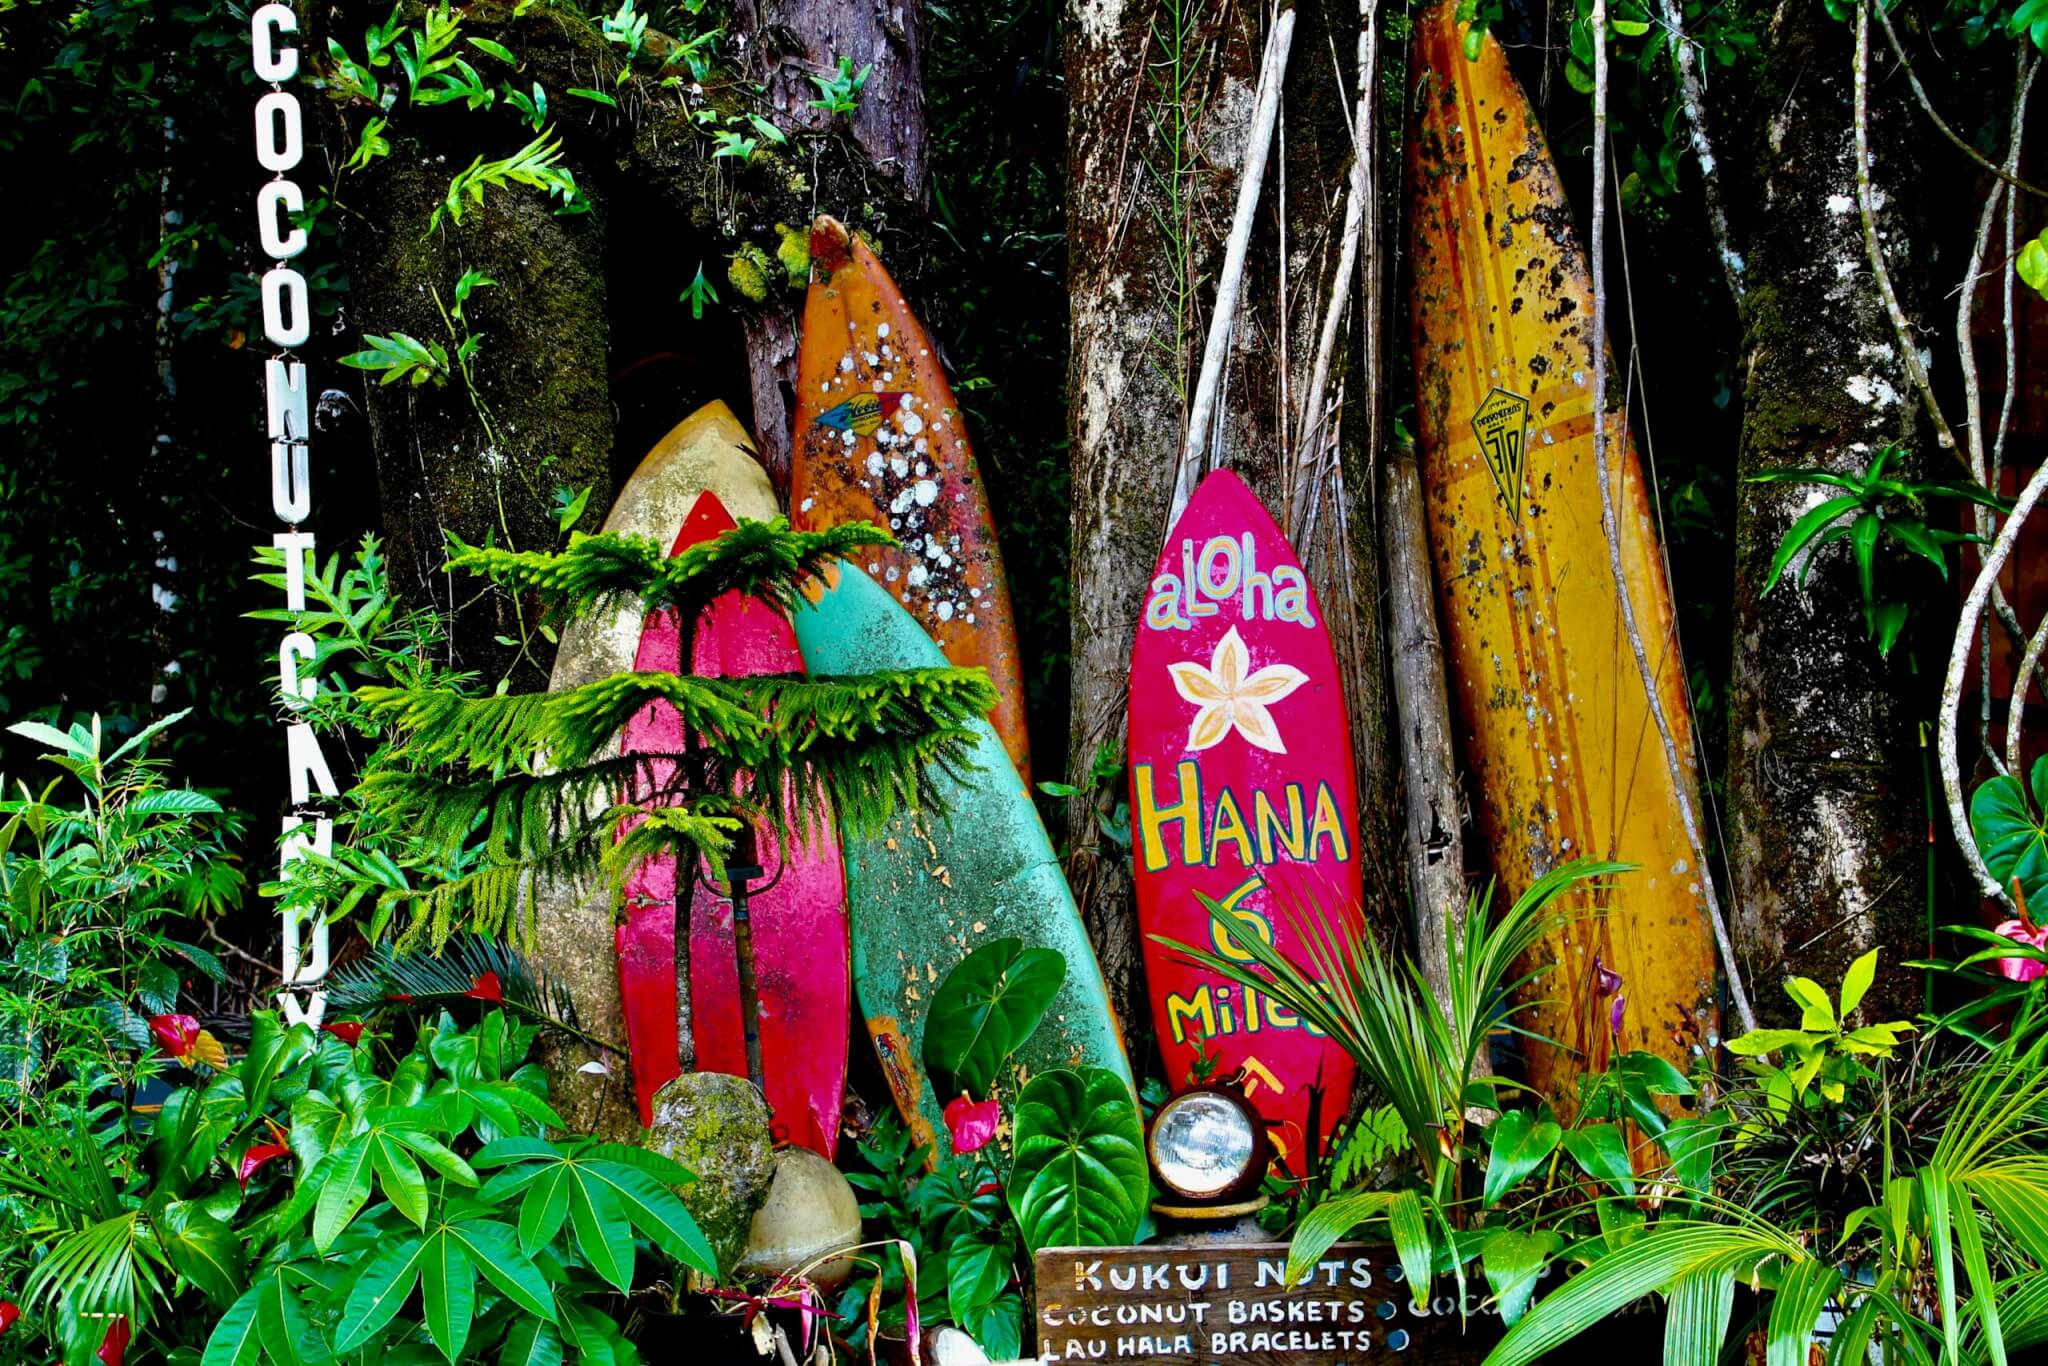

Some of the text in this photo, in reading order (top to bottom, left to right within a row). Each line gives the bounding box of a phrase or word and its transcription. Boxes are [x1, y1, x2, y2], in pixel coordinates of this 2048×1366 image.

[252, 3, 315, 611] COCONUT
[1135, 759, 1350, 873] HANA
[1209, 875, 1274, 964] 6
[1075, 1260, 1230, 1292] KUKUI
[1043, 1300, 1365, 1327] COCONUT BASKETS
[1044, 1331, 1371, 1362] LAU HALA BRACELETS
